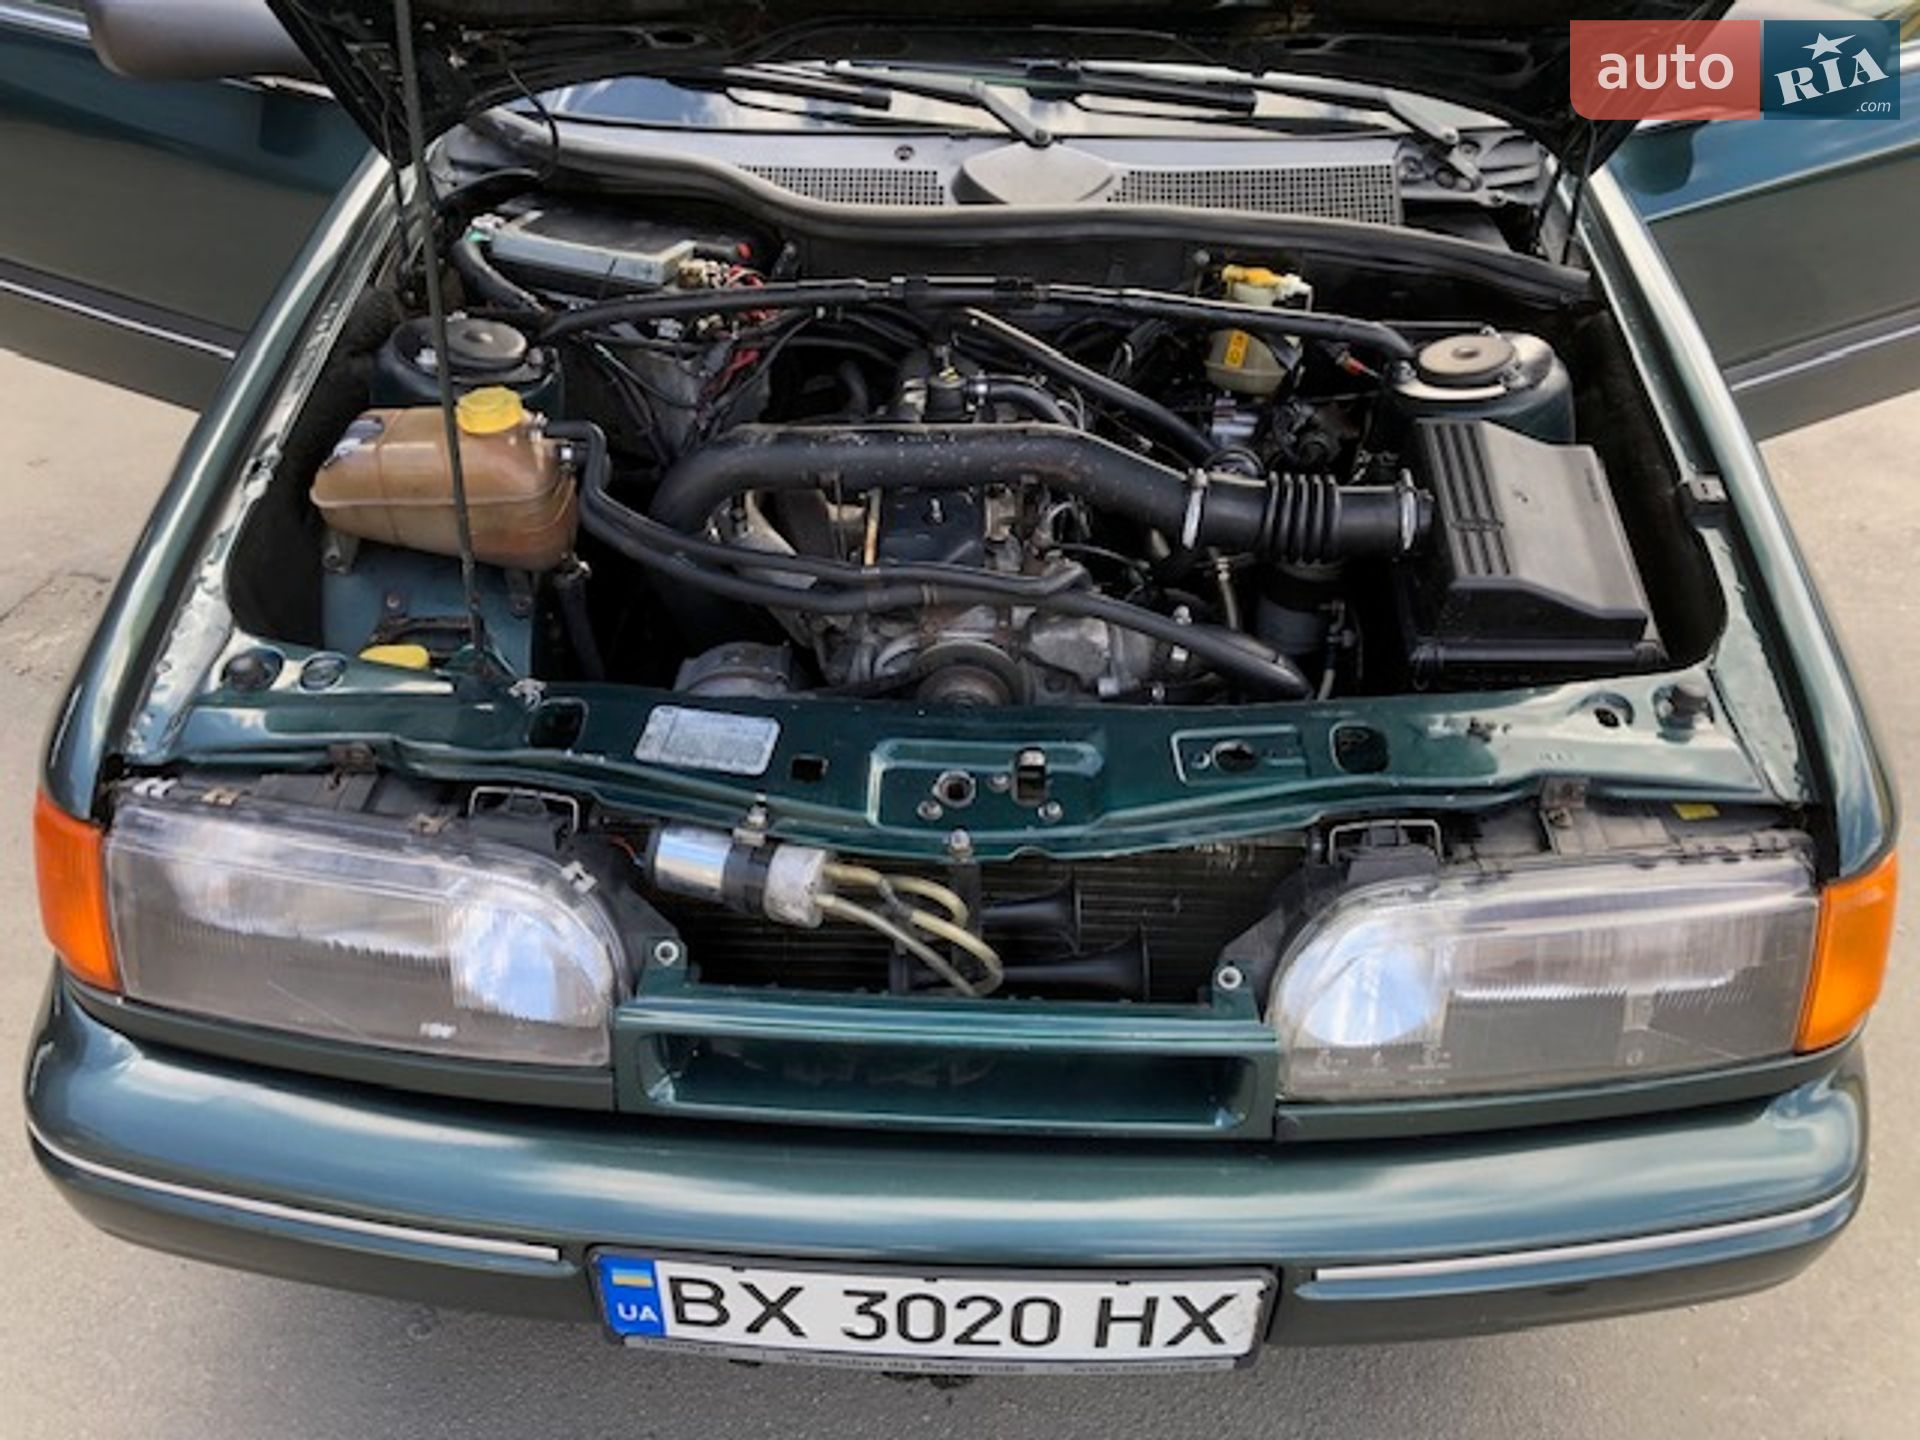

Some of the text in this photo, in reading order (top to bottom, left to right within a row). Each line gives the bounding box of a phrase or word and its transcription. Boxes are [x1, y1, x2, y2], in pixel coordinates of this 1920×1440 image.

[617, 1302, 658, 1323] UA
[669, 1277, 1238, 1348] BX 3020 HX
